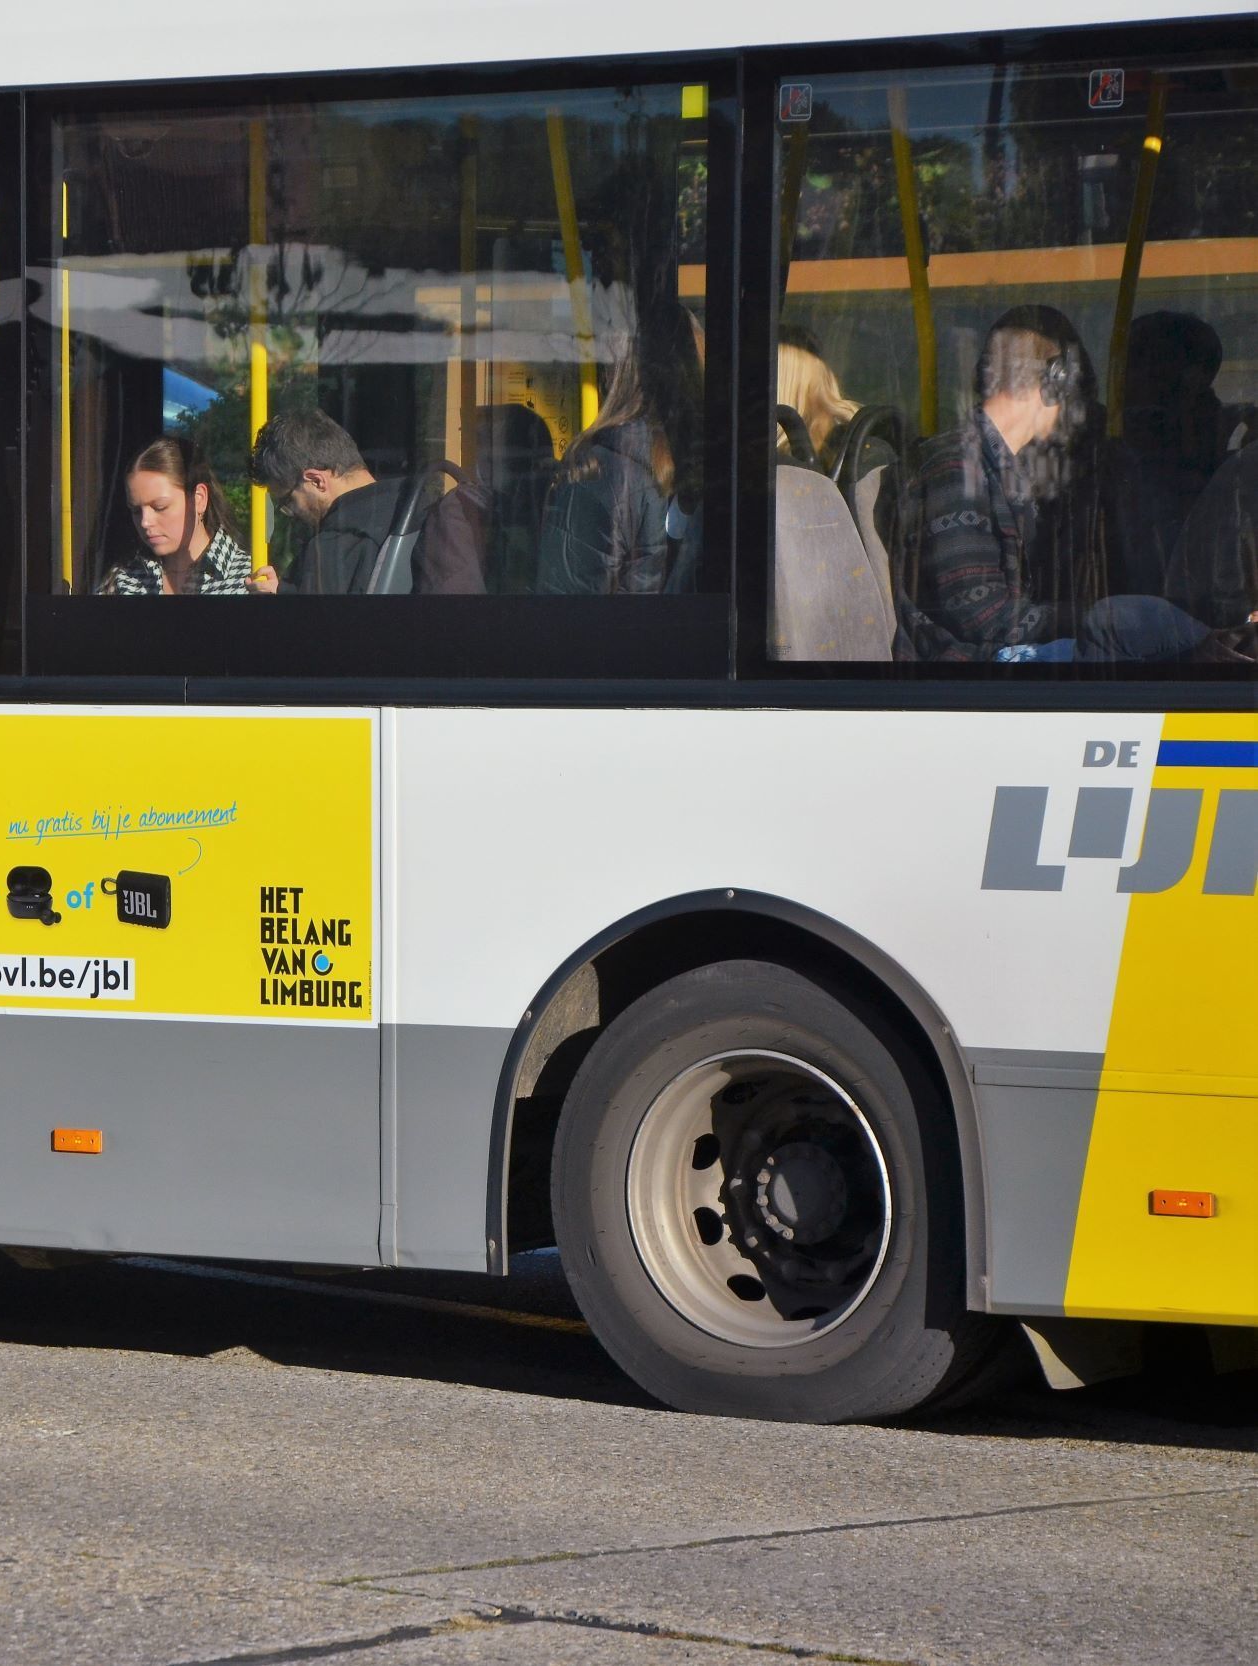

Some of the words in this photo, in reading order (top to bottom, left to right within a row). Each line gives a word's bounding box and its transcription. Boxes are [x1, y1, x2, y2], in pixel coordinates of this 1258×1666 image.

[1082, 740, 1142, 768] DE
[8, 819, 30, 835] nu
[35, 811, 83, 846] gratis
[92, 805, 112, 841] bij
[115, 805, 132, 841] je
[139, 800, 238, 830] abonnement
[66, 881, 95, 909] of
[122, 889, 158, 919] JBL
[260, 886, 304, 914] HET
[260, 917, 352, 948] BELANG
[261, 948, 306, 977] VAN
[260, 978, 363, 1009] LIMBURG
